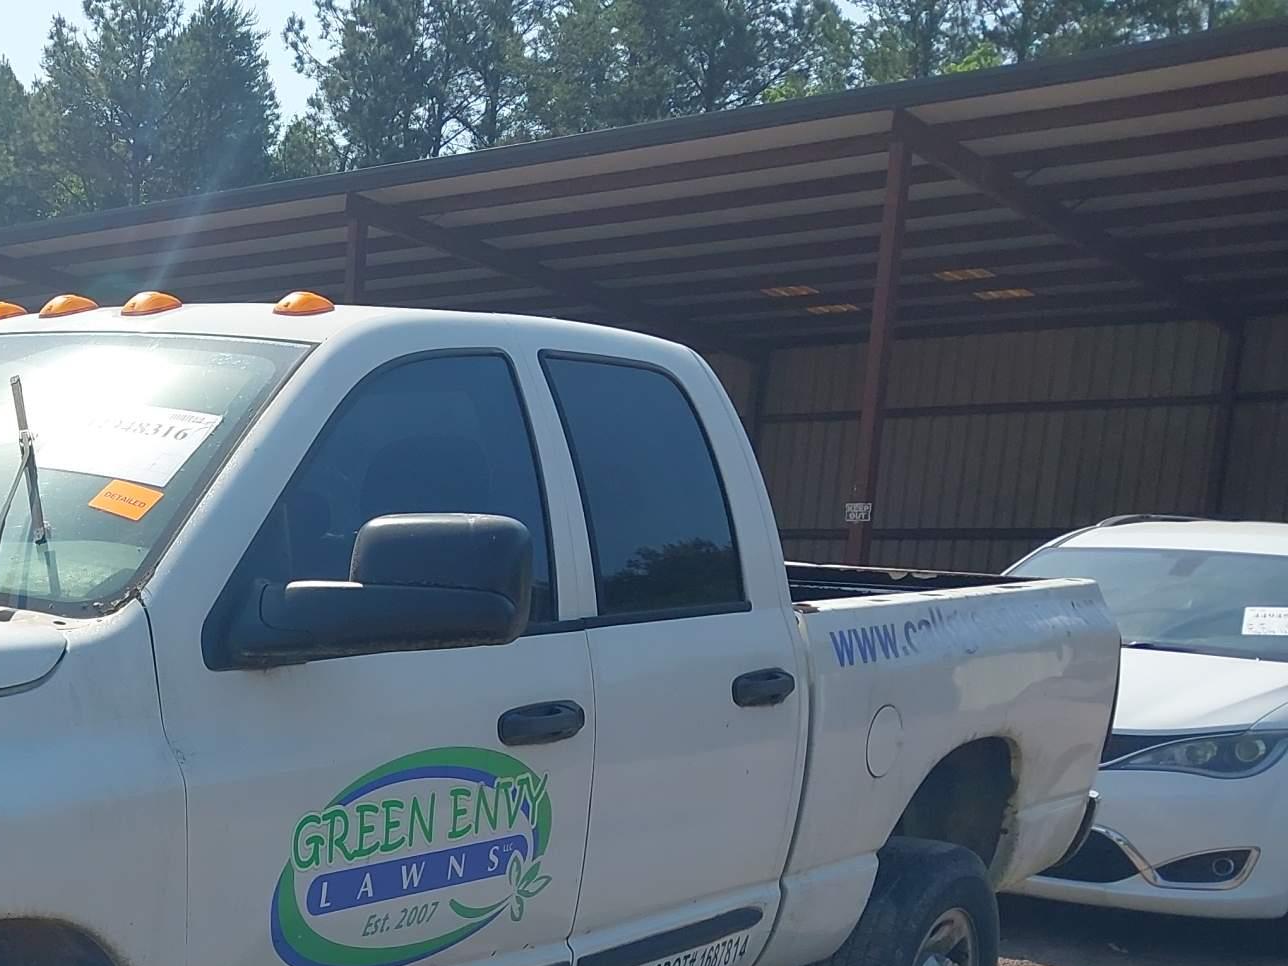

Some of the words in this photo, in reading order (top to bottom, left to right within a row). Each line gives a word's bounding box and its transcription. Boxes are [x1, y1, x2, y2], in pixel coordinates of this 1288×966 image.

[104, 491, 147, 509] DETAILED
[849, 512, 867, 520] OUT
[292, 792, 436, 869] GREEN
[447, 773, 548, 839] ENVY
[319, 845, 500, 908] LAWNS
[362, 913, 390, 937] Est.
[394, 901, 440, 930] 2007
